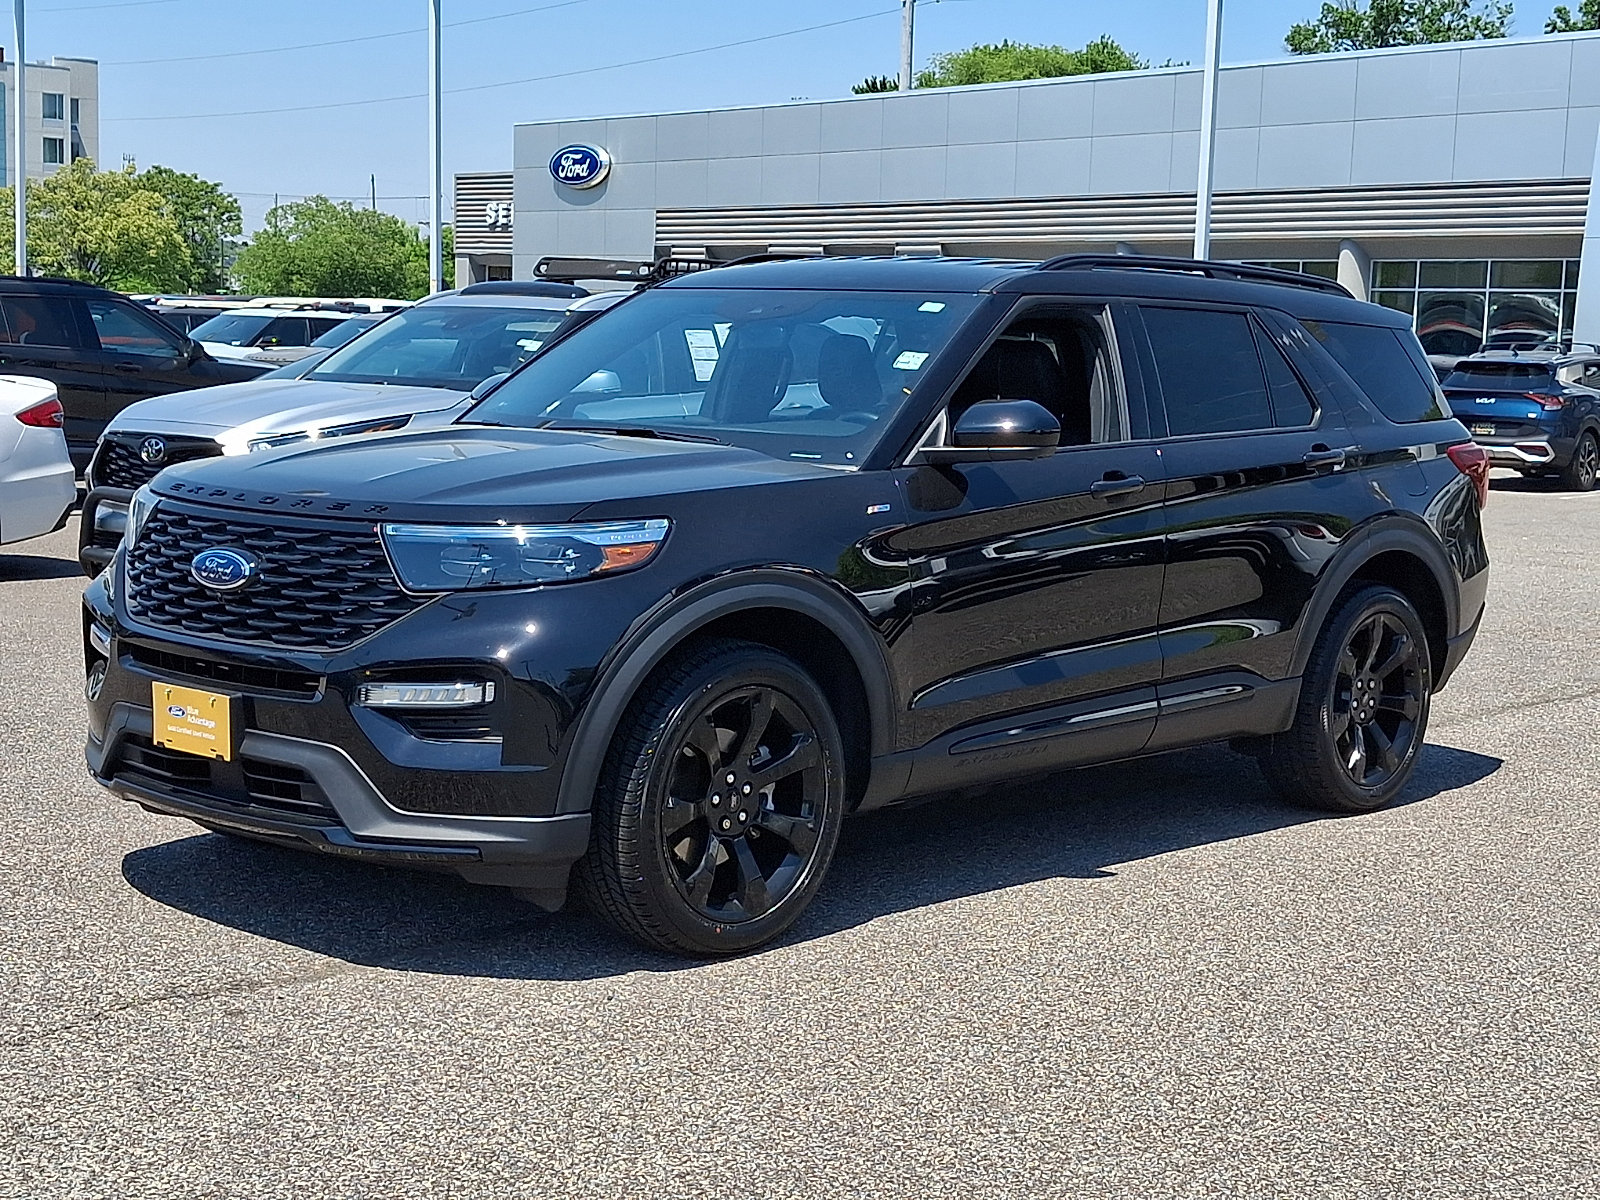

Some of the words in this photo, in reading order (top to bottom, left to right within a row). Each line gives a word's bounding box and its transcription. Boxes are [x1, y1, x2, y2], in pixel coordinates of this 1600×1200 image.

[558, 153, 591, 178] Ford
[485, 202, 515, 225] SE
[169, 482, 389, 515] EXPLORER
[200, 555, 235, 581] Ford
